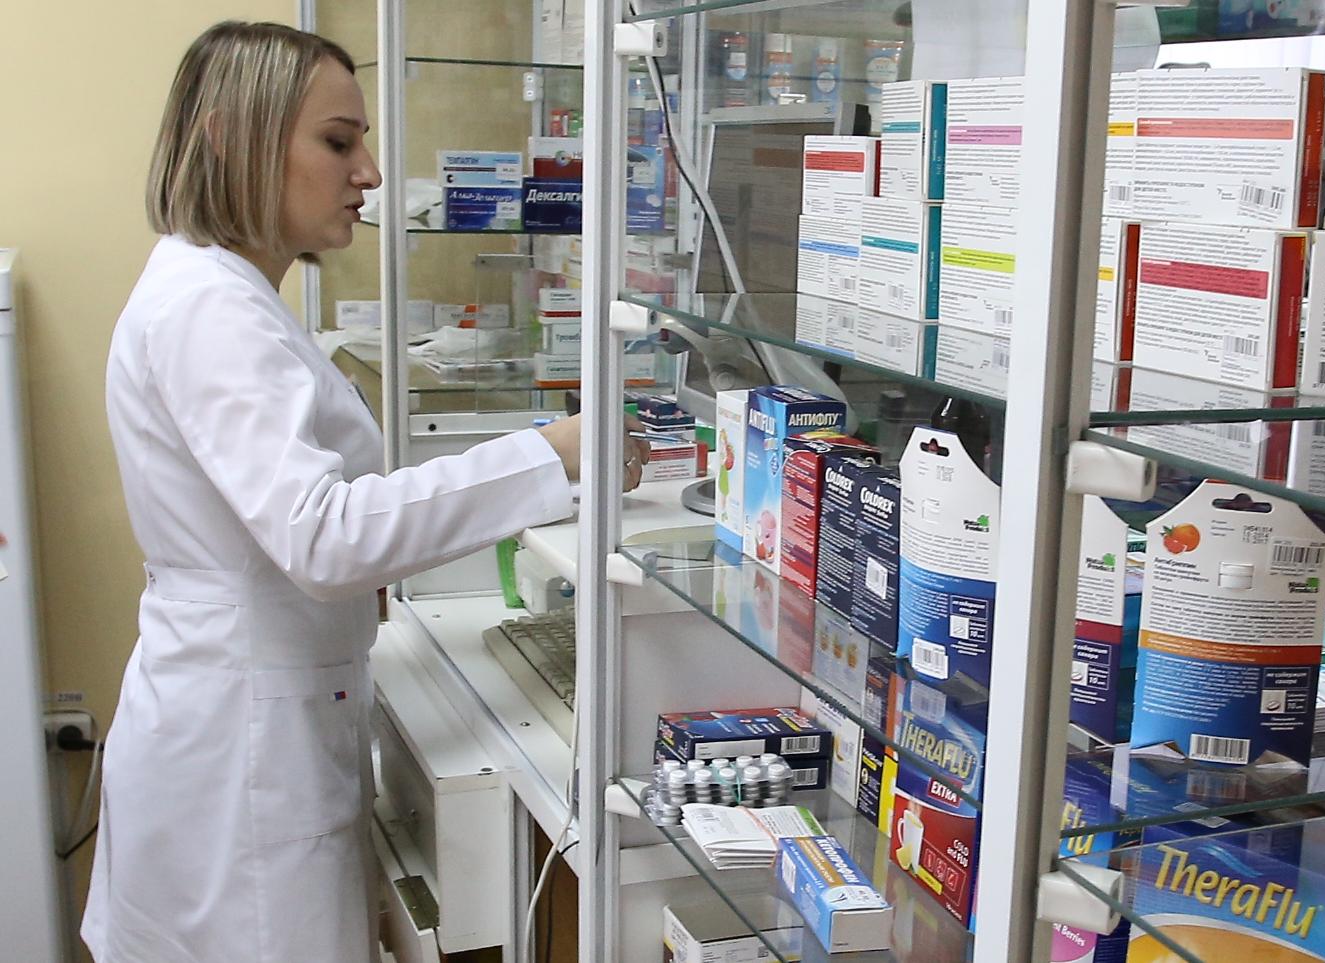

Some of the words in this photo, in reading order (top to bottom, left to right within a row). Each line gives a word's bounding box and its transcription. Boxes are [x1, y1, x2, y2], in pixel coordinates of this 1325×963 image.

[788, 413, 838, 426] АНТИФЛУ
[825, 466, 855, 492] COLDREX
[861, 486, 895, 513] COLDREX
[900, 714, 973, 780] THERAFLU
[815, 838, 860, 883] КЕТОПРОФЕН
[1154, 844, 1316, 939] TheraFlu
[1061, 925, 1086, 948] Berries
